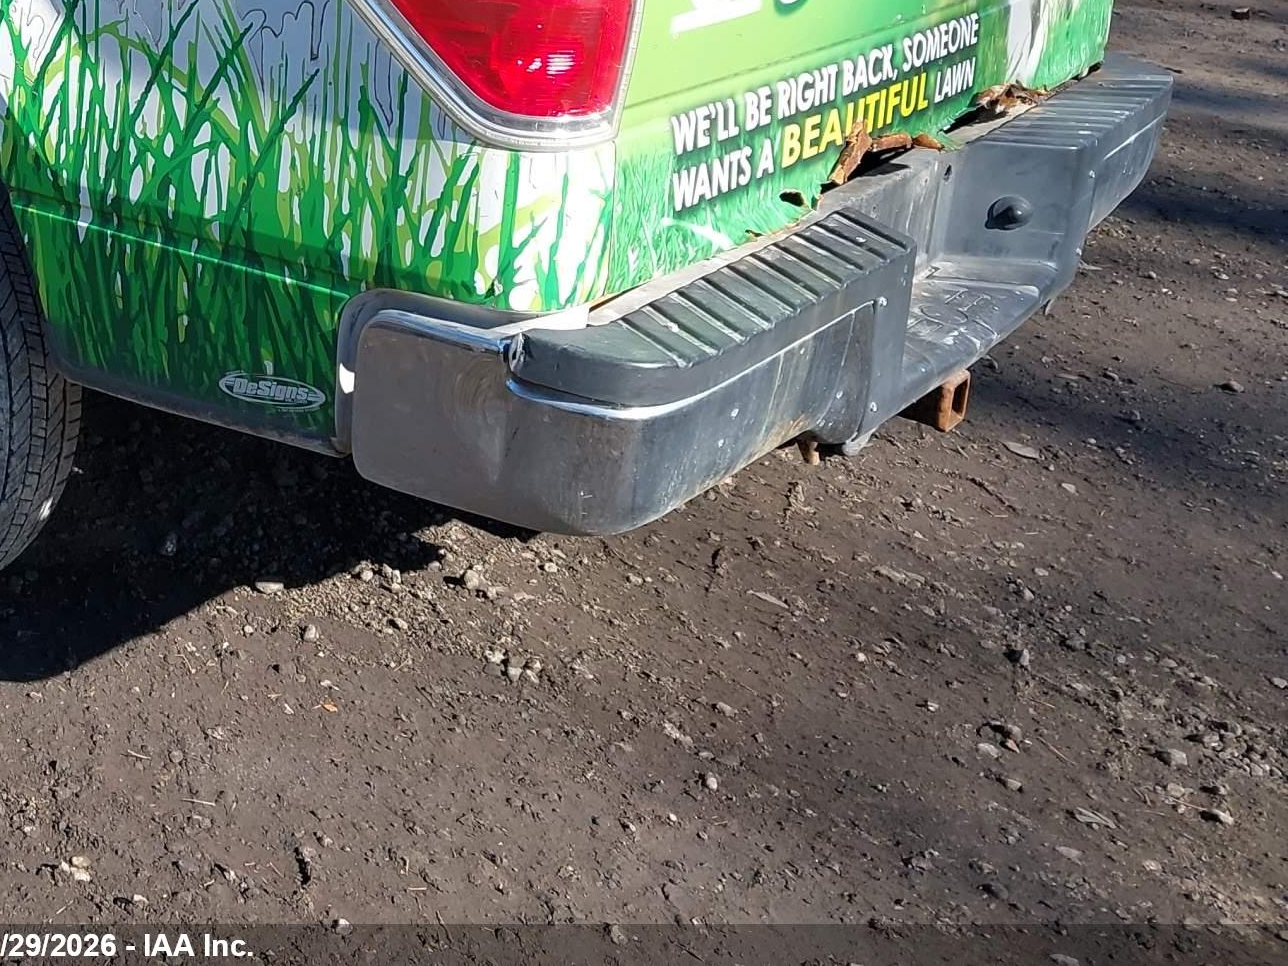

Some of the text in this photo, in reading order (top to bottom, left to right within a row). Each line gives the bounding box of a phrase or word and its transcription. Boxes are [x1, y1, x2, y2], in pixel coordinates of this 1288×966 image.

[672, 12, 979, 155] WE'LL BE RIGHT BACK, SOMEONE
[673, 57, 976, 212] WANTS A BEAUTIFUL LAWN
